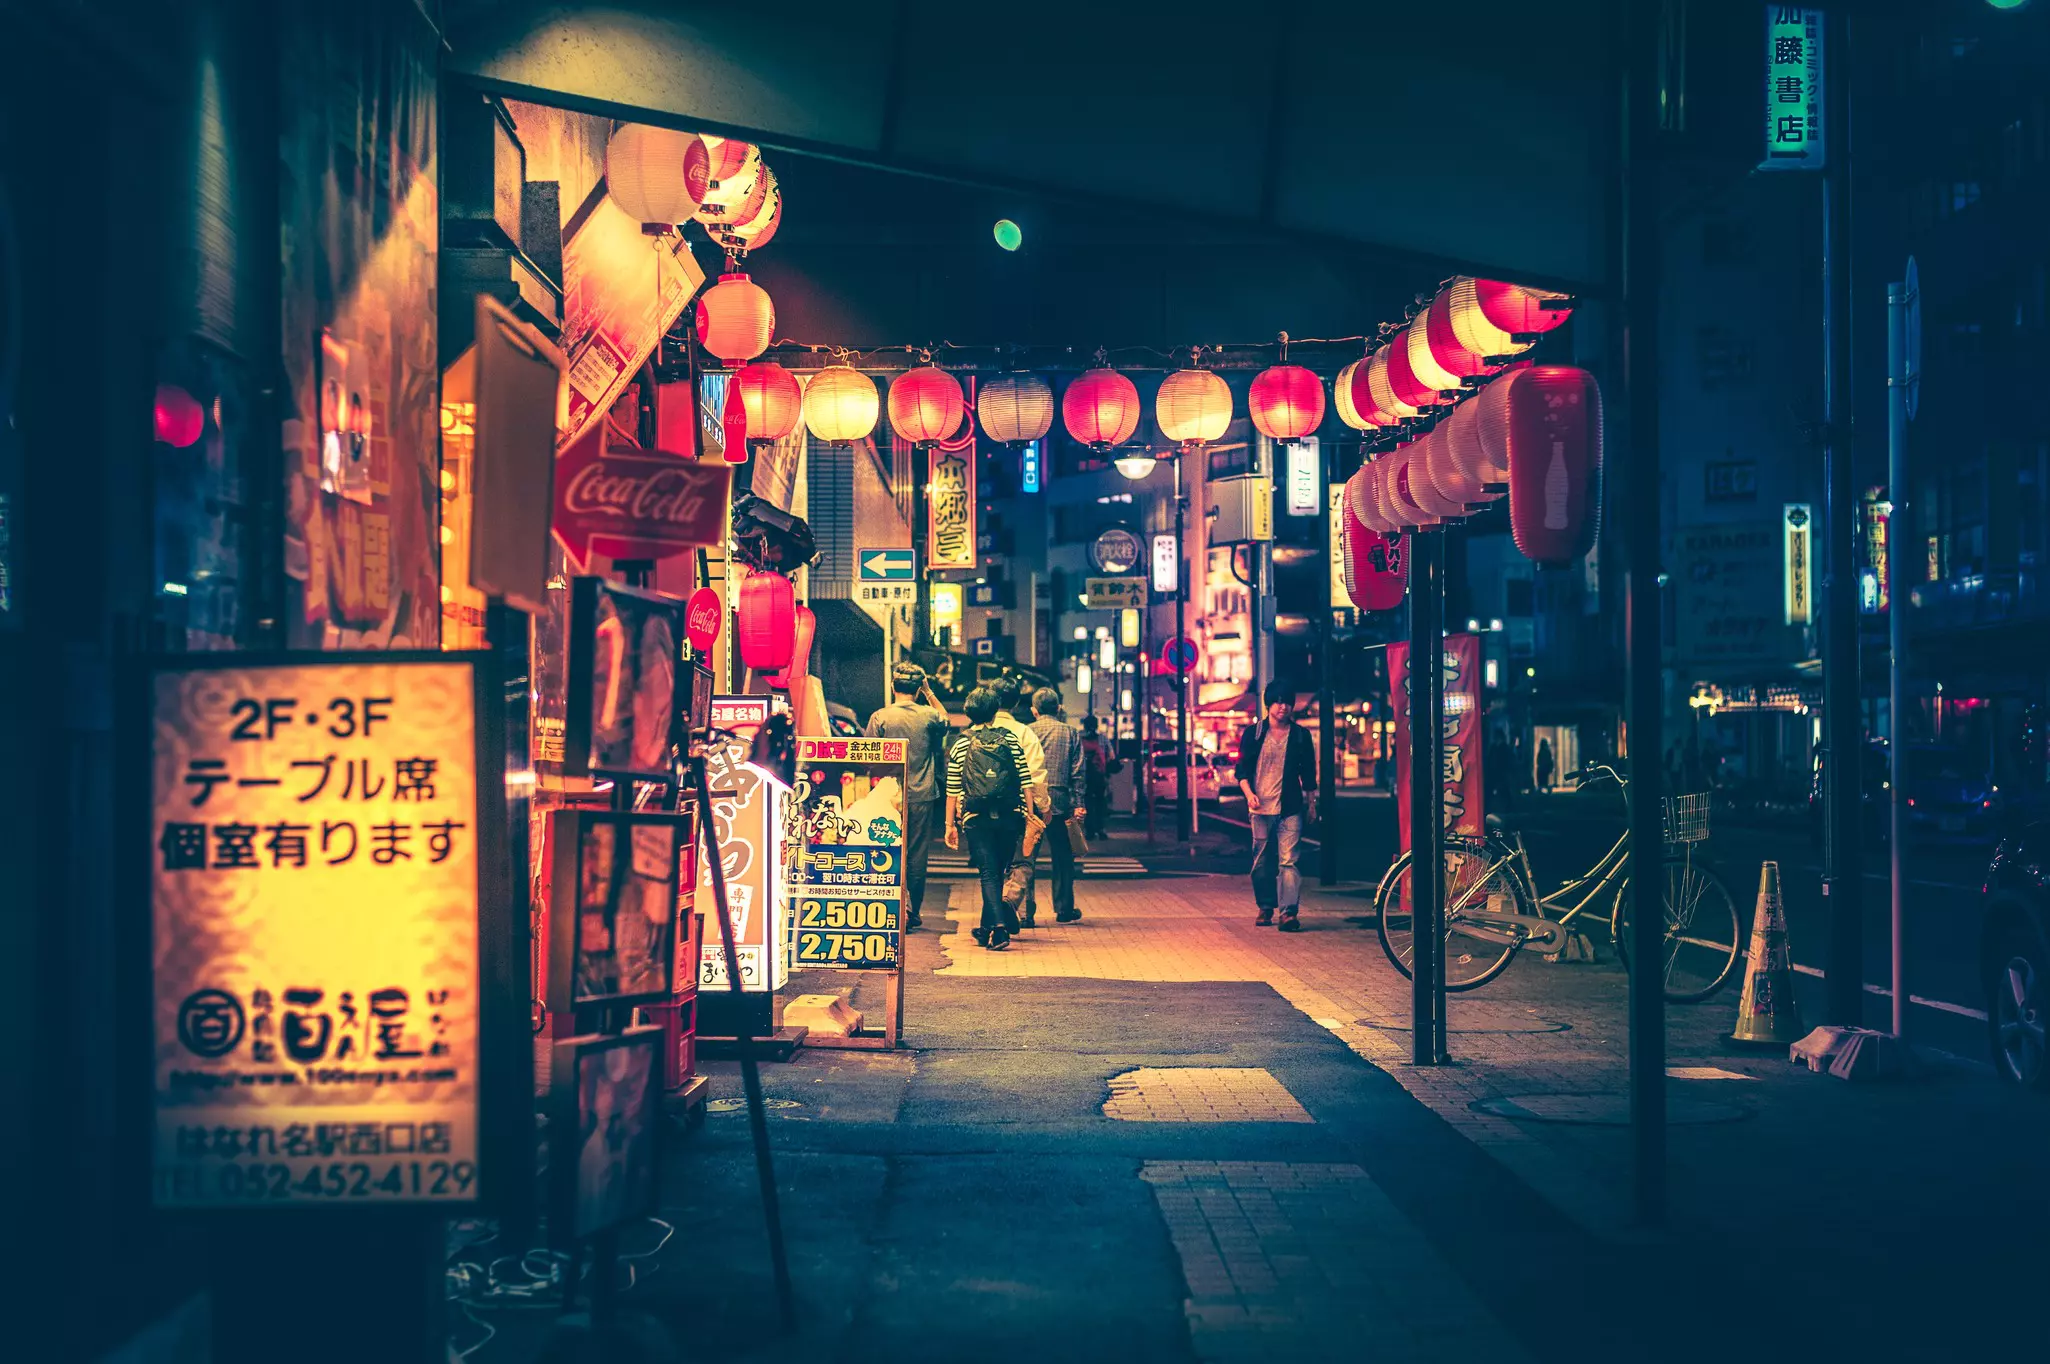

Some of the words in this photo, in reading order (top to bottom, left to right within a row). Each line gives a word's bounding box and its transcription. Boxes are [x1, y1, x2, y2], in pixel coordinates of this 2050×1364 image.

[1775, 7, 1804, 142] 加藤書店
[565, 462, 717, 523] Coca-Cola
[690, 603, 717, 634] Coca-Cola
[850, 742, 880, 752] 金太郎
[850, 752, 880, 761] 名駅1号店
[884, 744, 901, 754] 24h
[185, 756, 438, 806] テーブル席
[160, 819, 466, 871] 個室有ります
[176, 1120, 452, 1157] はなれ名駅西口店
[218, 1161, 475, 1198] 052-452-4129
